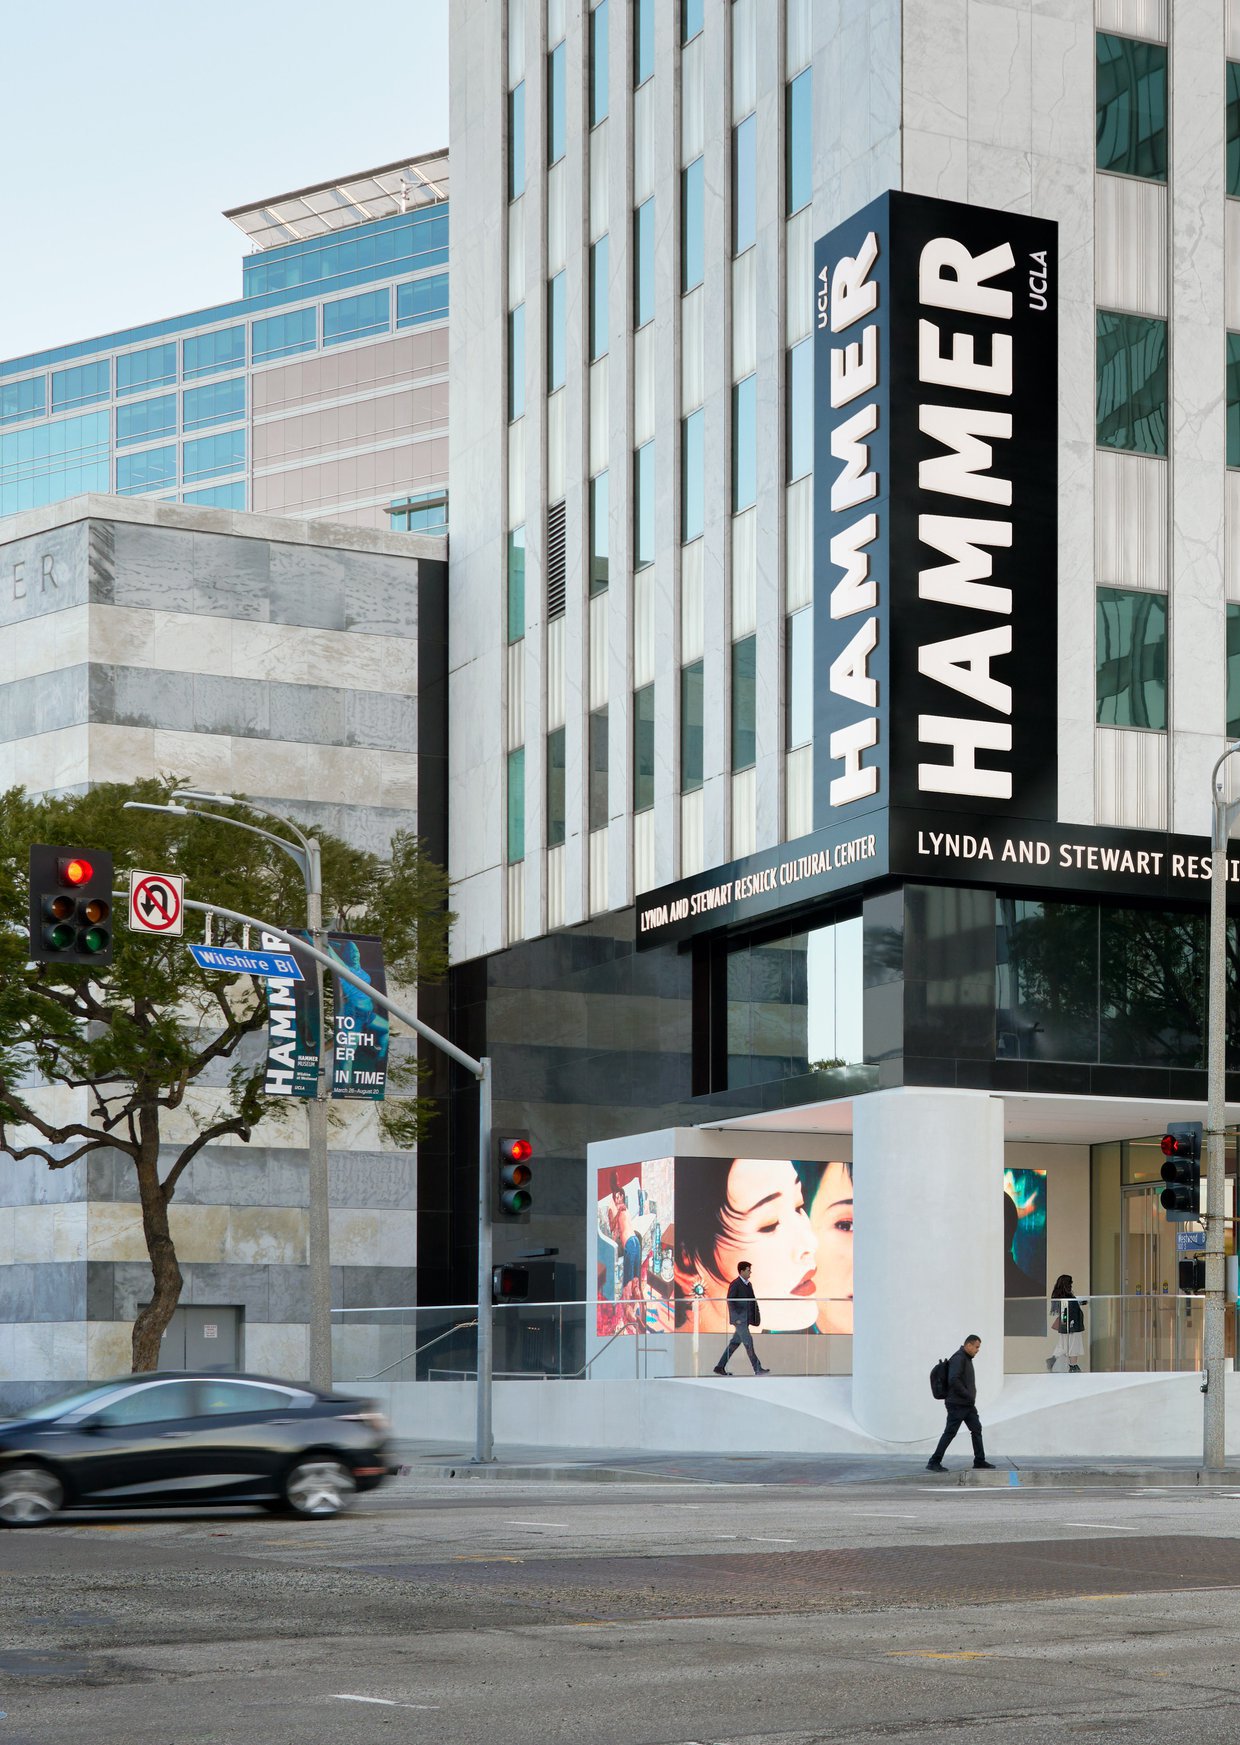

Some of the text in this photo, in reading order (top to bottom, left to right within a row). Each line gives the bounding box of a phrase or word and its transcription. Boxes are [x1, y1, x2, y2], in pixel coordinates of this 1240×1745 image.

[818, 265, 829, 329] UCLA
[1029, 250, 1047, 311] UCLA
[830, 231, 879, 807] HAMMER
[918, 237, 1016, 800] HAMMER
[918, 831, 994, 861] LYNDA
[1001, 839, 1050, 865] AND
[1059, 844, 1163, 876] STEWART
[640, 834, 877, 932] LYNDA AND STEWART RESNICK CULTURAL CENTER
[198, 950, 270, 971] Wilshire
[262, 929, 297, 1095] HAMMR
[336, 1016, 355, 1030] TO
[336, 1032, 374, 1047] GETH
[336, 1047, 355, 1061] ER
[336, 1070, 384, 1085] IN TIME
